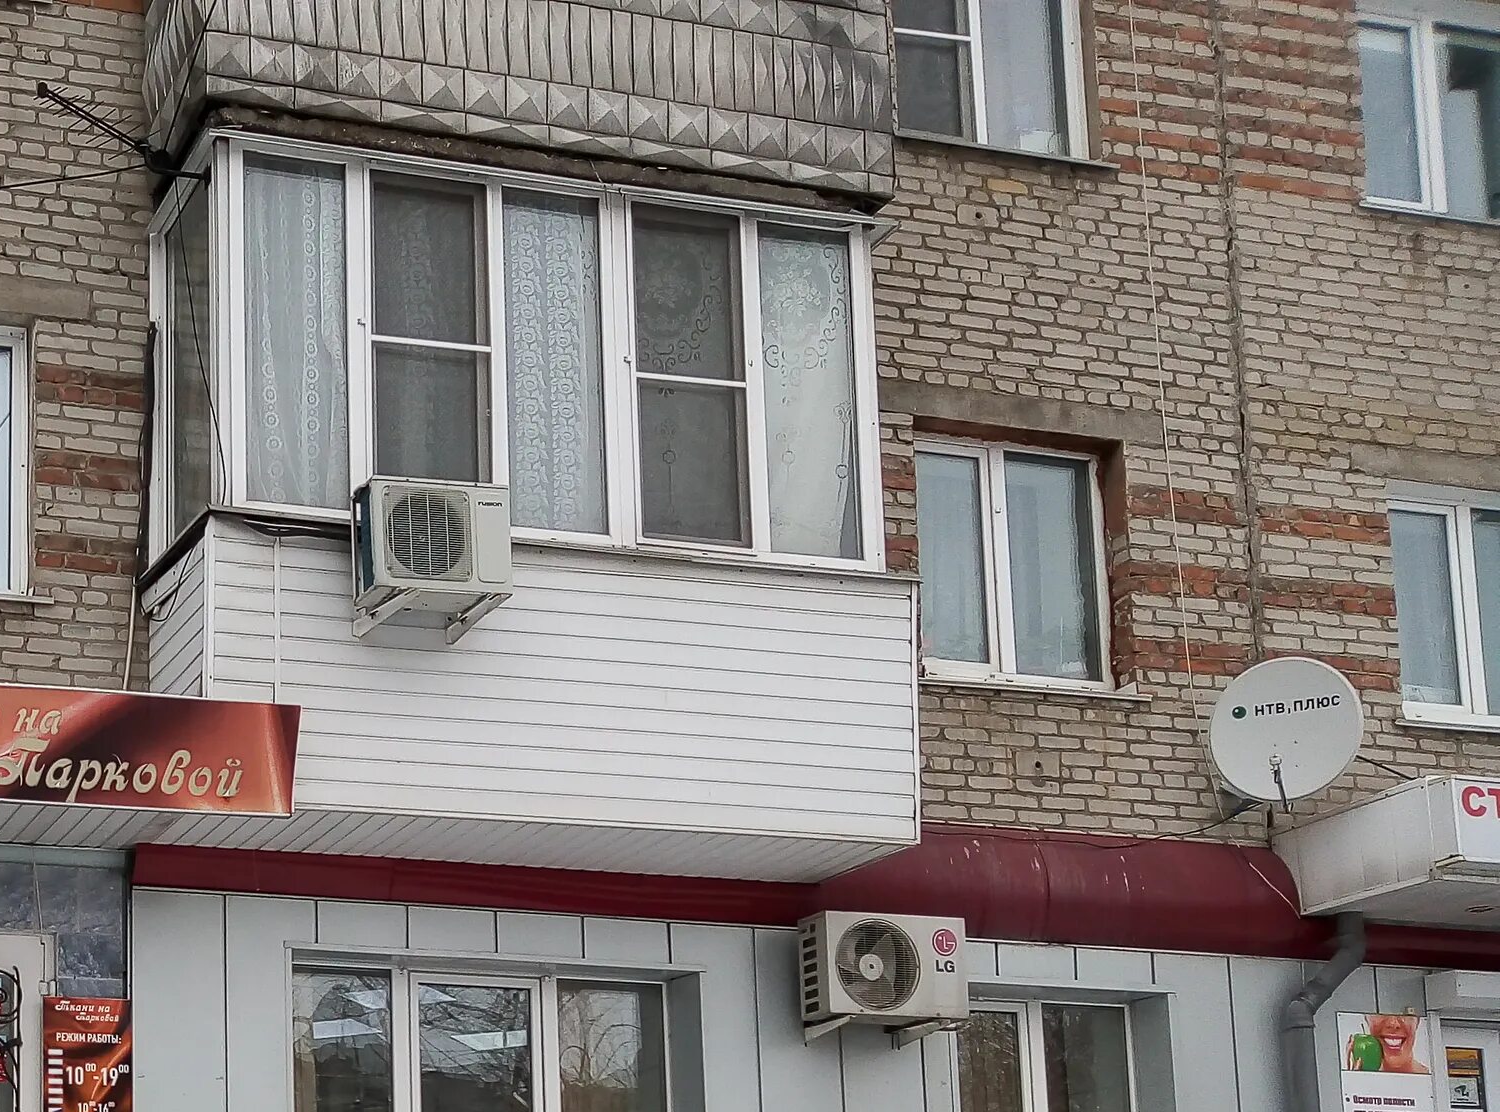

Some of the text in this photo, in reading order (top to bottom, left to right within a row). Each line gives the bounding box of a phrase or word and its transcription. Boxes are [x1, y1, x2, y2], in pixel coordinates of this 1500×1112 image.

[12, 707, 63, 735] на
[935, 959, 956, 973] LG
[55, 1000, 111, 1013] Ткани на
[56, 1032, 122, 1045] РЕЖИМ РАБОТЫ:
[1353, 1095, 1382, 1105] Осмотр
